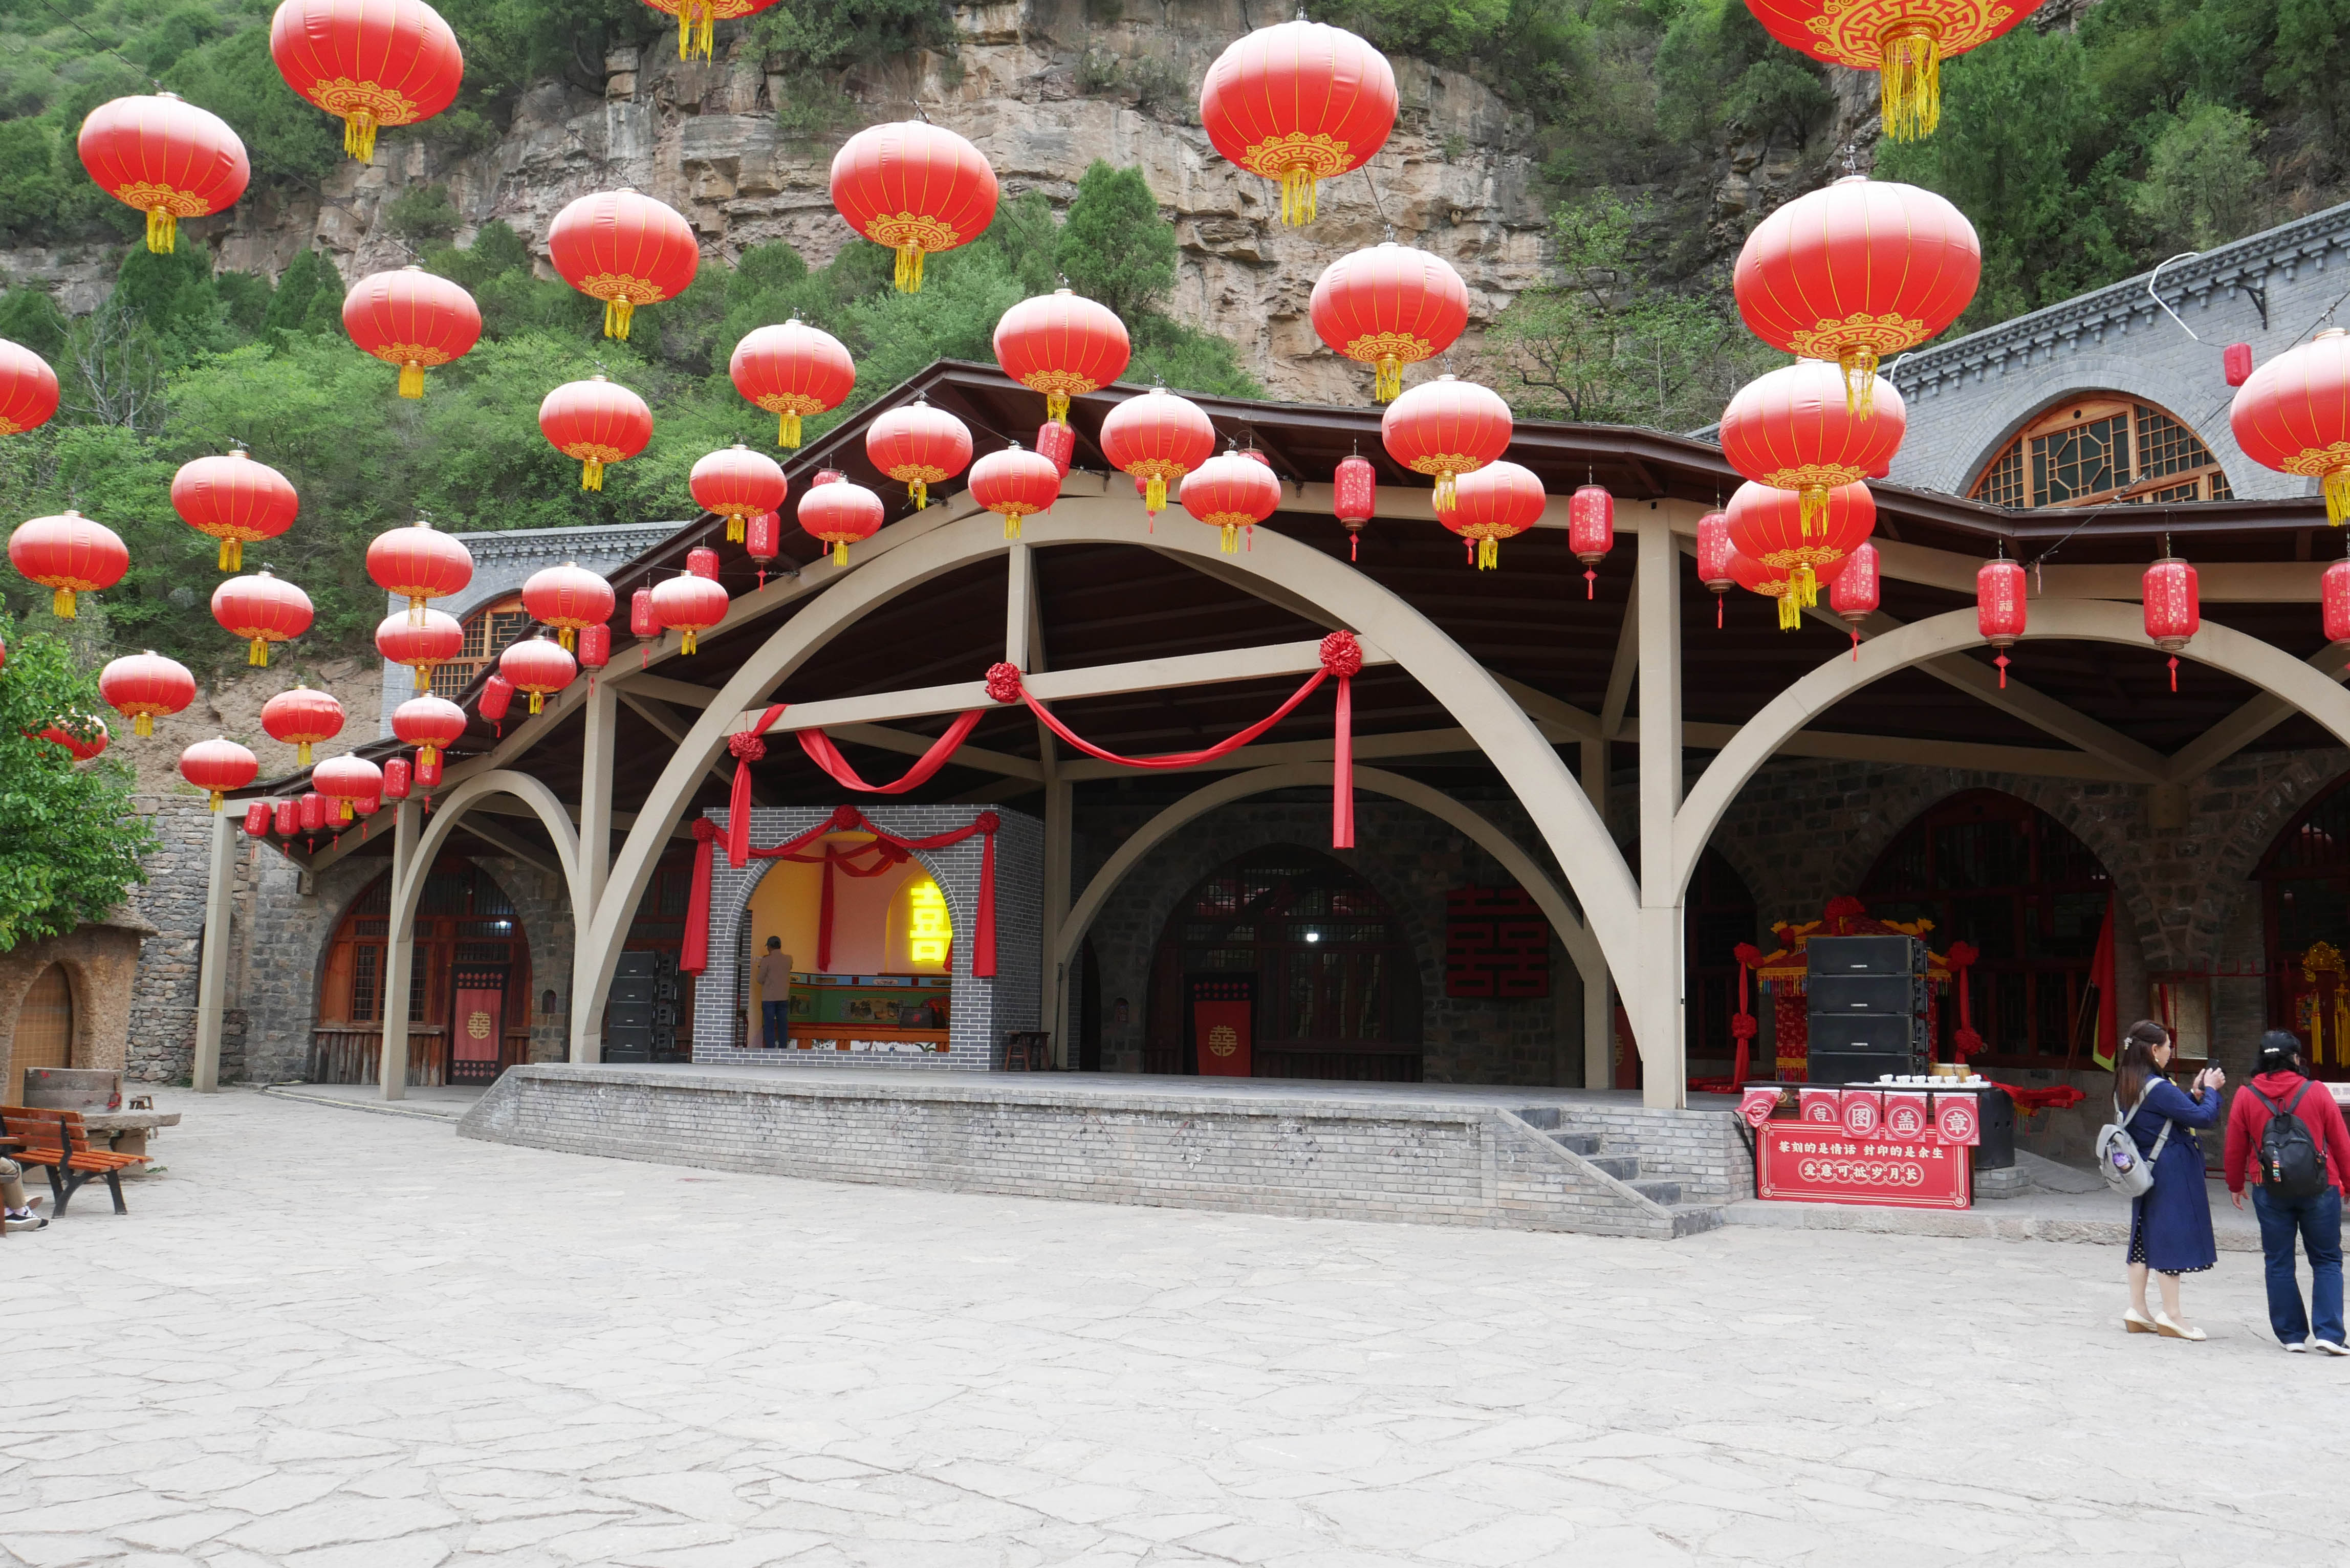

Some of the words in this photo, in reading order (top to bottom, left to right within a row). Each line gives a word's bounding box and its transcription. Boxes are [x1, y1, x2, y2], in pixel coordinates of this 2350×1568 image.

[1999, 600, 2013, 612] 福
[1852, 1108, 1871, 1128] 图
[1895, 1110, 1917, 1132] 盖
[1946, 1112, 1968, 1135] 章
[1778, 1140, 1857, 1155] 篆刻的是情话
[1863, 1144, 1944, 1159] 封印的是余生
[1804, 1163, 1918, 1181] 爱意可抵岁月长
